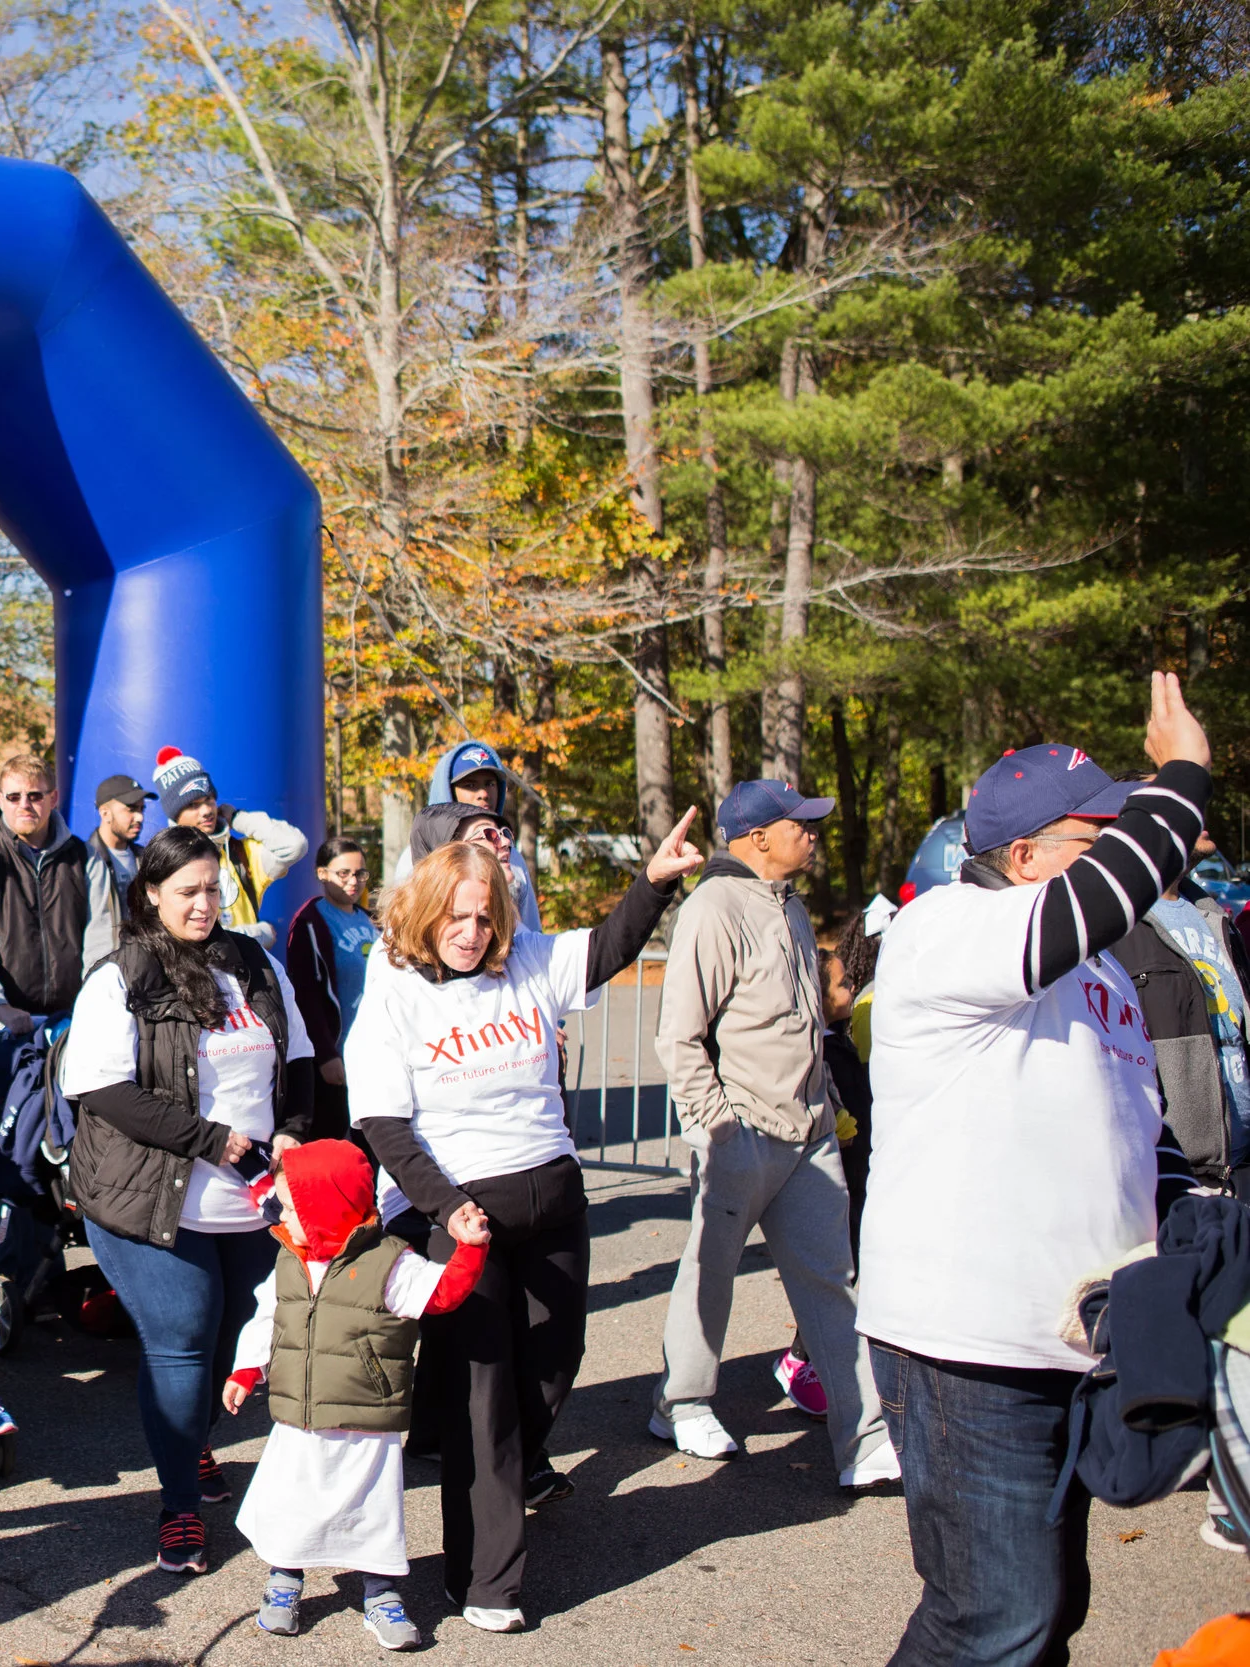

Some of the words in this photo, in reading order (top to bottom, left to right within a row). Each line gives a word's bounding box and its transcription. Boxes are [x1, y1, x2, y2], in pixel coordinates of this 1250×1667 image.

[160, 760, 201, 790] PATRIO
[425, 1006, 542, 1065] xfinity
[197, 1047, 228, 1058] future
[230, 1044, 241, 1055] of
[242, 1042, 277, 1053] awesom
[441, 1073, 460, 1085] the
[462, 1066, 496, 1080] future
[498, 1061, 510, 1072] of
